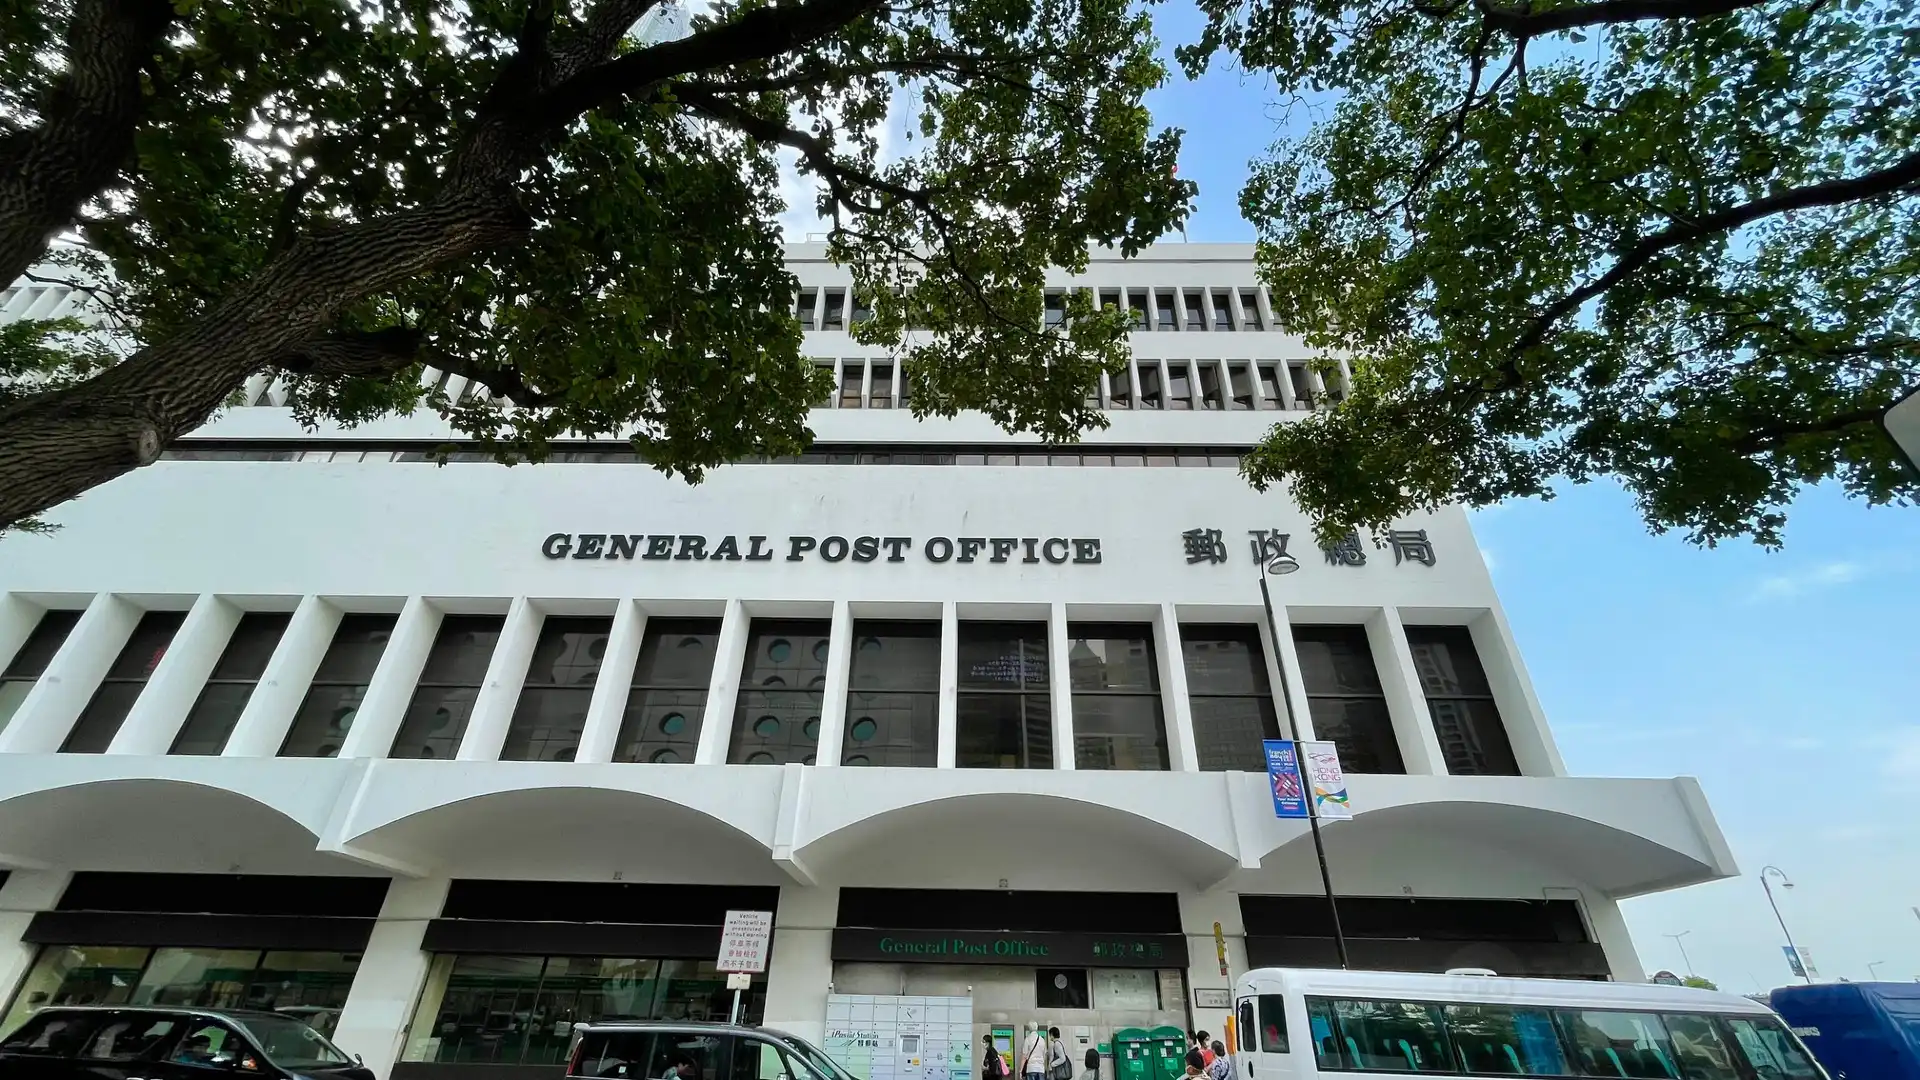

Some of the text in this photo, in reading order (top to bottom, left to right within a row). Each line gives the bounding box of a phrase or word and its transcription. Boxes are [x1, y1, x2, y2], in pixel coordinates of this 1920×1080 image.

[541, 532, 1102, 564] GENERAL POST OFFICE
[880, 937, 1049, 956] General Post Office
[831, 1029, 855, 1038] iPostal
